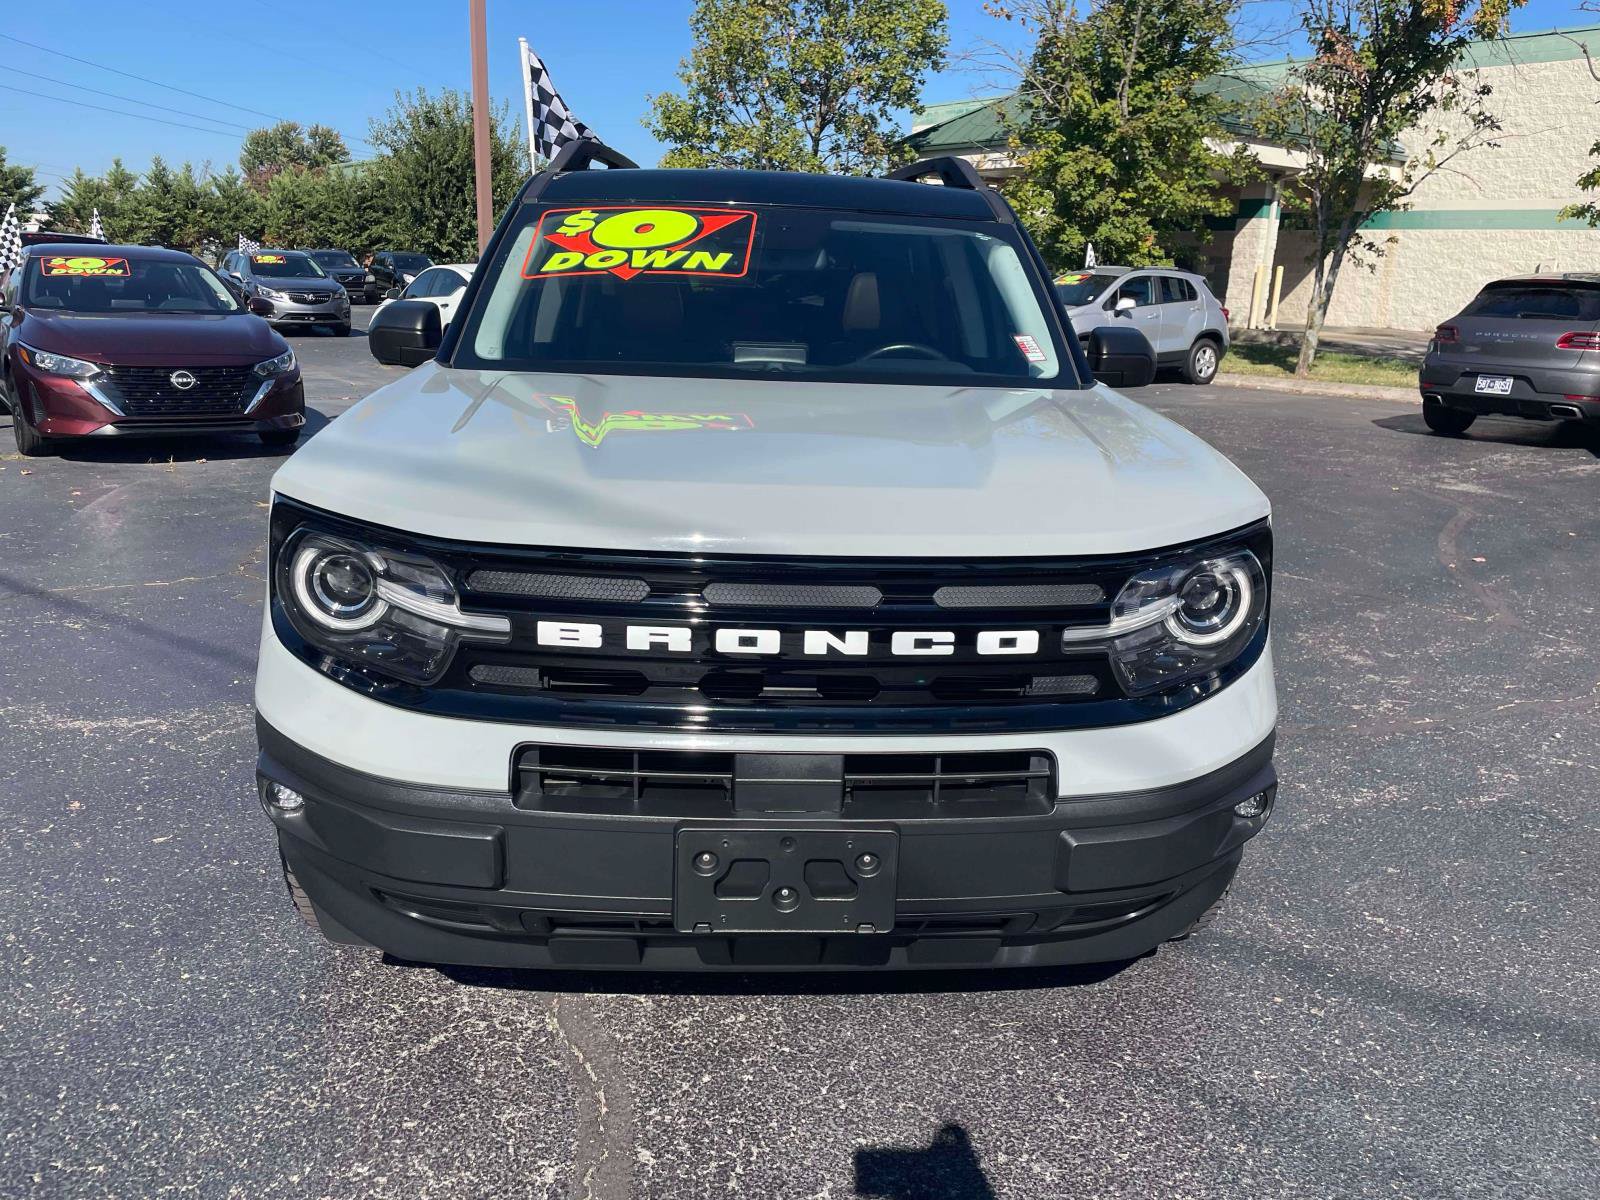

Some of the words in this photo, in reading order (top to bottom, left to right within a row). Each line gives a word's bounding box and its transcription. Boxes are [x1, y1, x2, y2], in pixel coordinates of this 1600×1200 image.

[556, 209, 698, 249] $0
[540, 250, 733, 272] DOWN
[537, 621, 1039, 656] BRONCO
